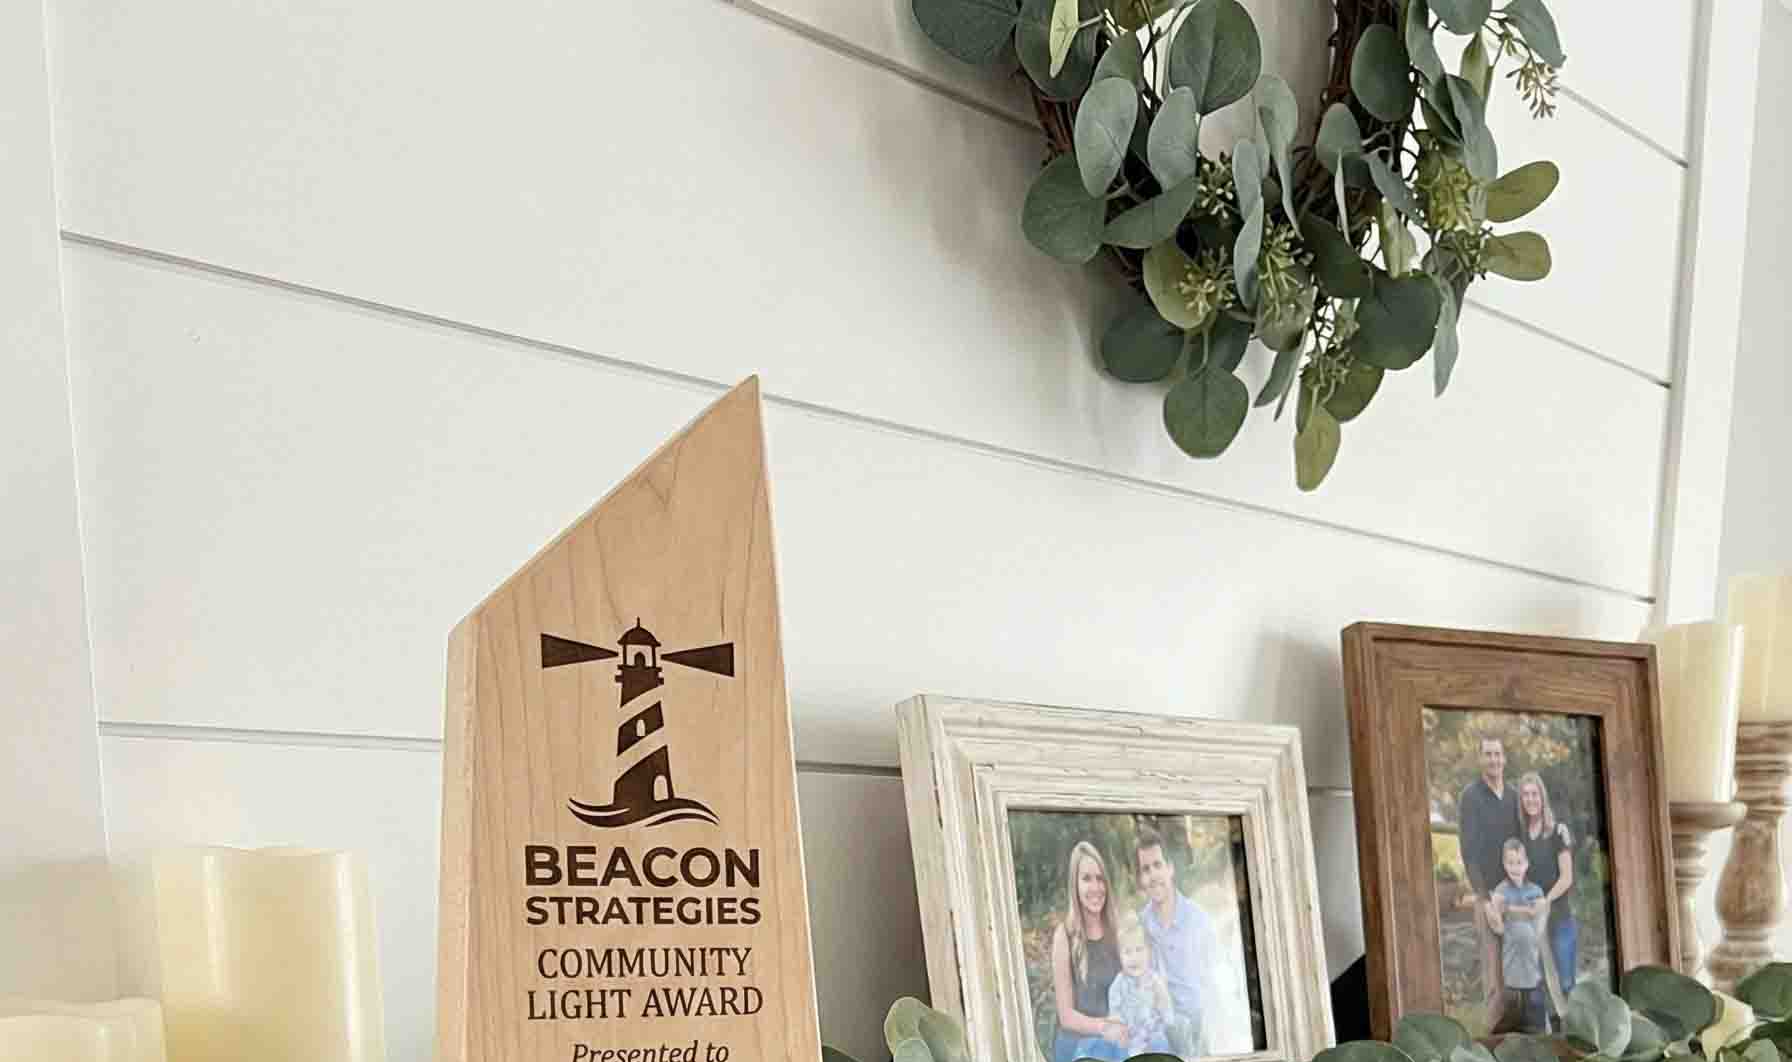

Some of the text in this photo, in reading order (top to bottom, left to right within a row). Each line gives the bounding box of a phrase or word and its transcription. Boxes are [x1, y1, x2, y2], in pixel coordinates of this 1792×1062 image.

[524, 844, 760, 888] BEACON
[525, 895, 762, 926] STRATEGIES
[537, 946, 753, 980] COMMUNITY
[527, 986, 764, 1021] LIGHT AWARD
